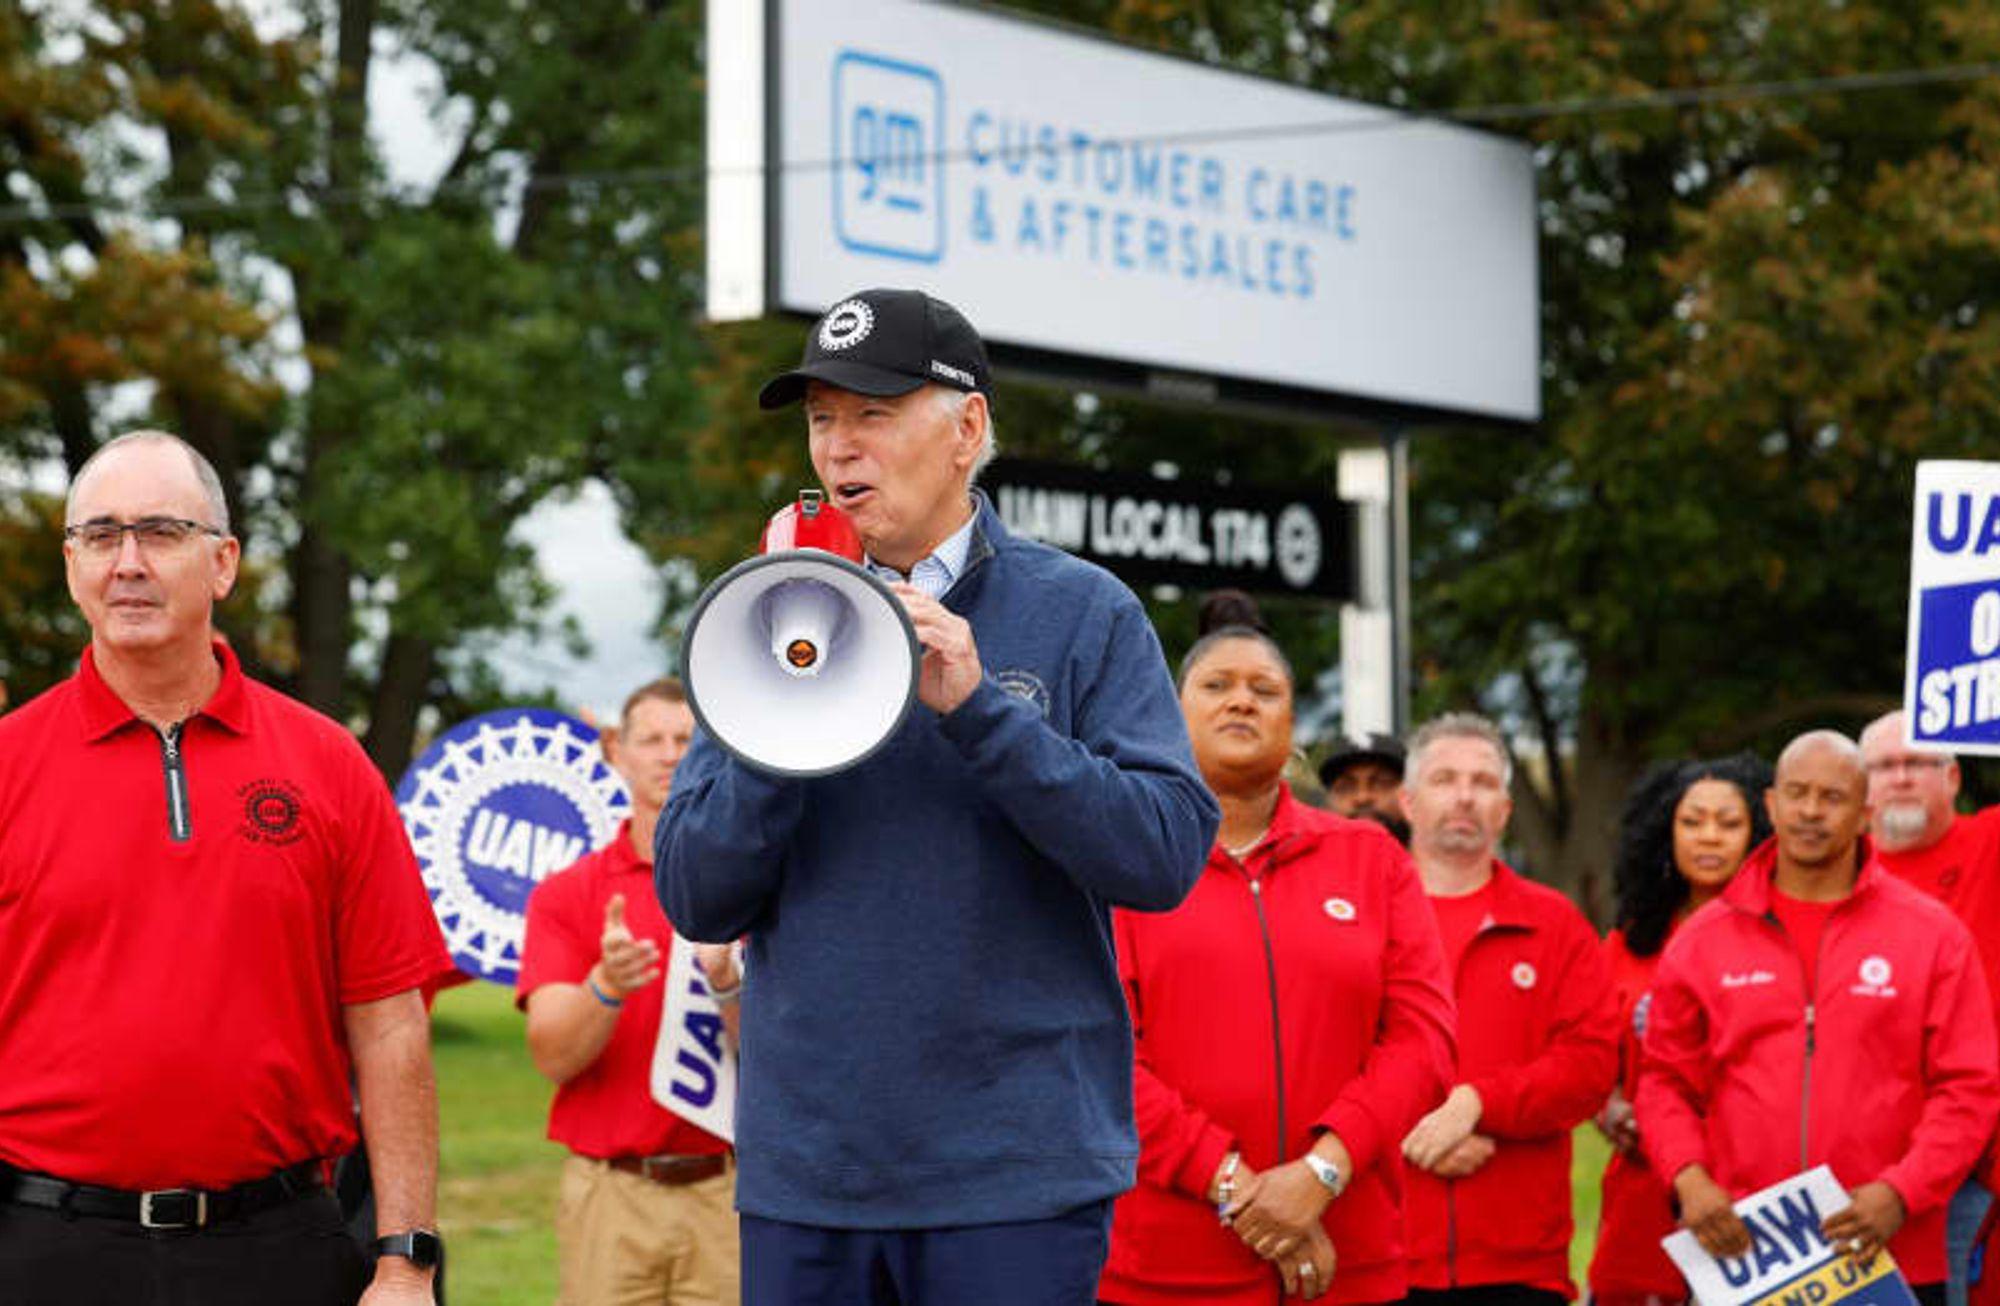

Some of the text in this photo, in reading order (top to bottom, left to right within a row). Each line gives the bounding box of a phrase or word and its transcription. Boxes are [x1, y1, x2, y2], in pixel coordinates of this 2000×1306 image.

[851, 104, 925, 203] gm
[966, 112, 1358, 242] CUSTOMER CARE
[969, 188, 1316, 299] & AFTERSALES
[999, 484, 1270, 568] UAW LOCAL 174
[466, 807, 587, 882] UAW
